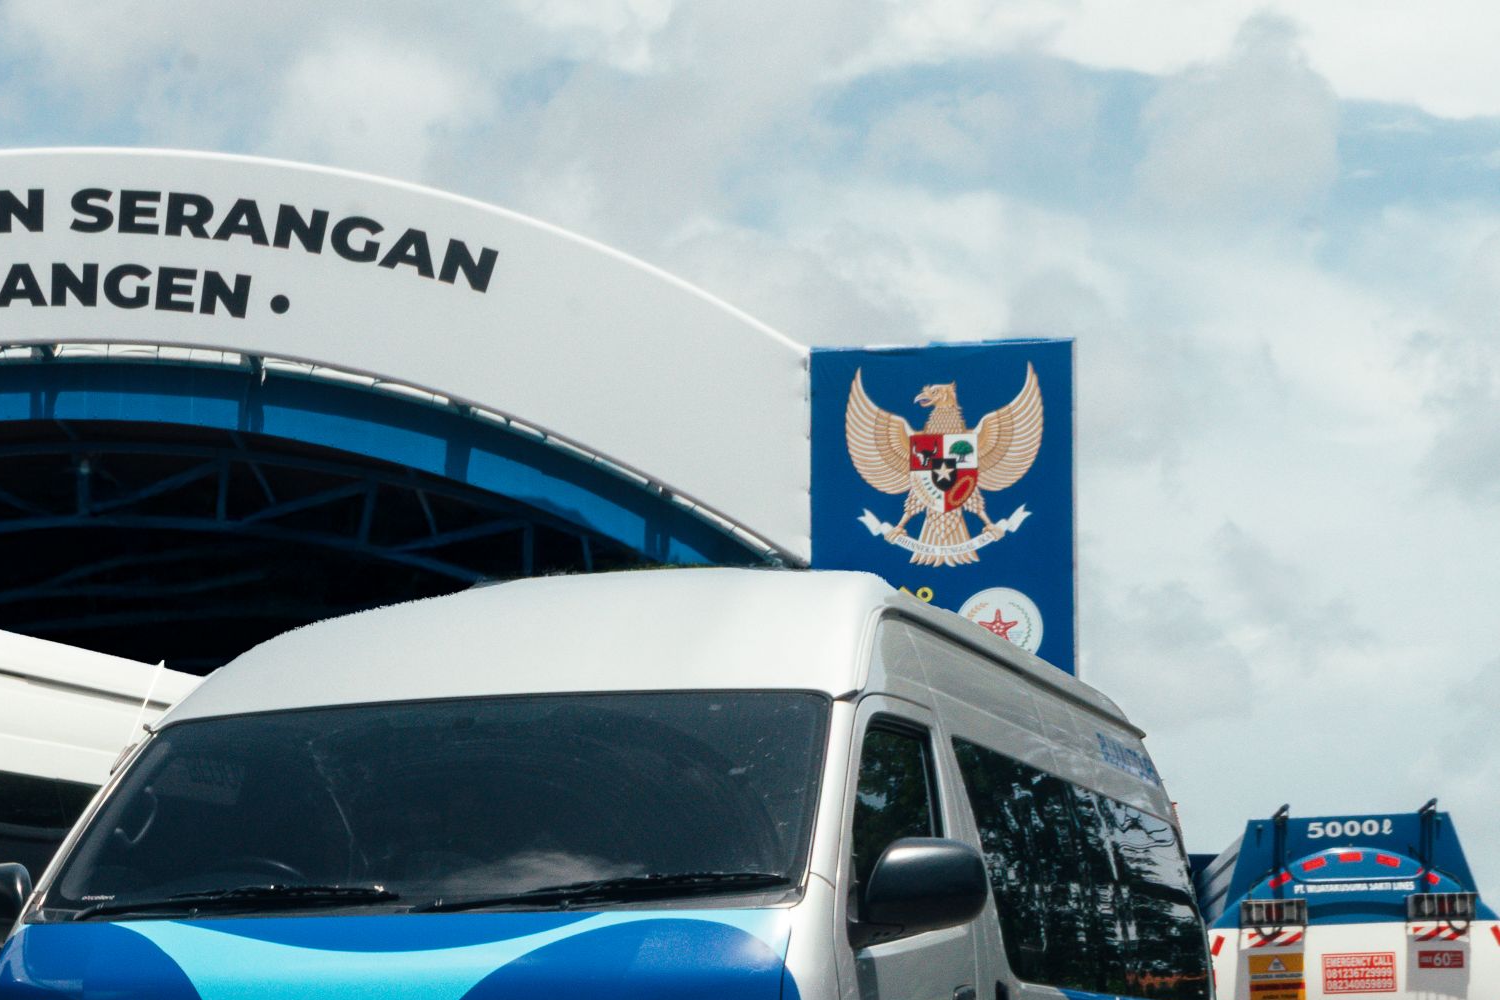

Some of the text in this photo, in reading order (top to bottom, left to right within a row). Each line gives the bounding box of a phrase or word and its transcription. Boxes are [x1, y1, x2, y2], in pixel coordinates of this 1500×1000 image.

[69, 187, 499, 294] SERANGAN
[1325, 955, 1393, 967] EMERGENCY CALL
[1434, 952, 1451, 966] 60
